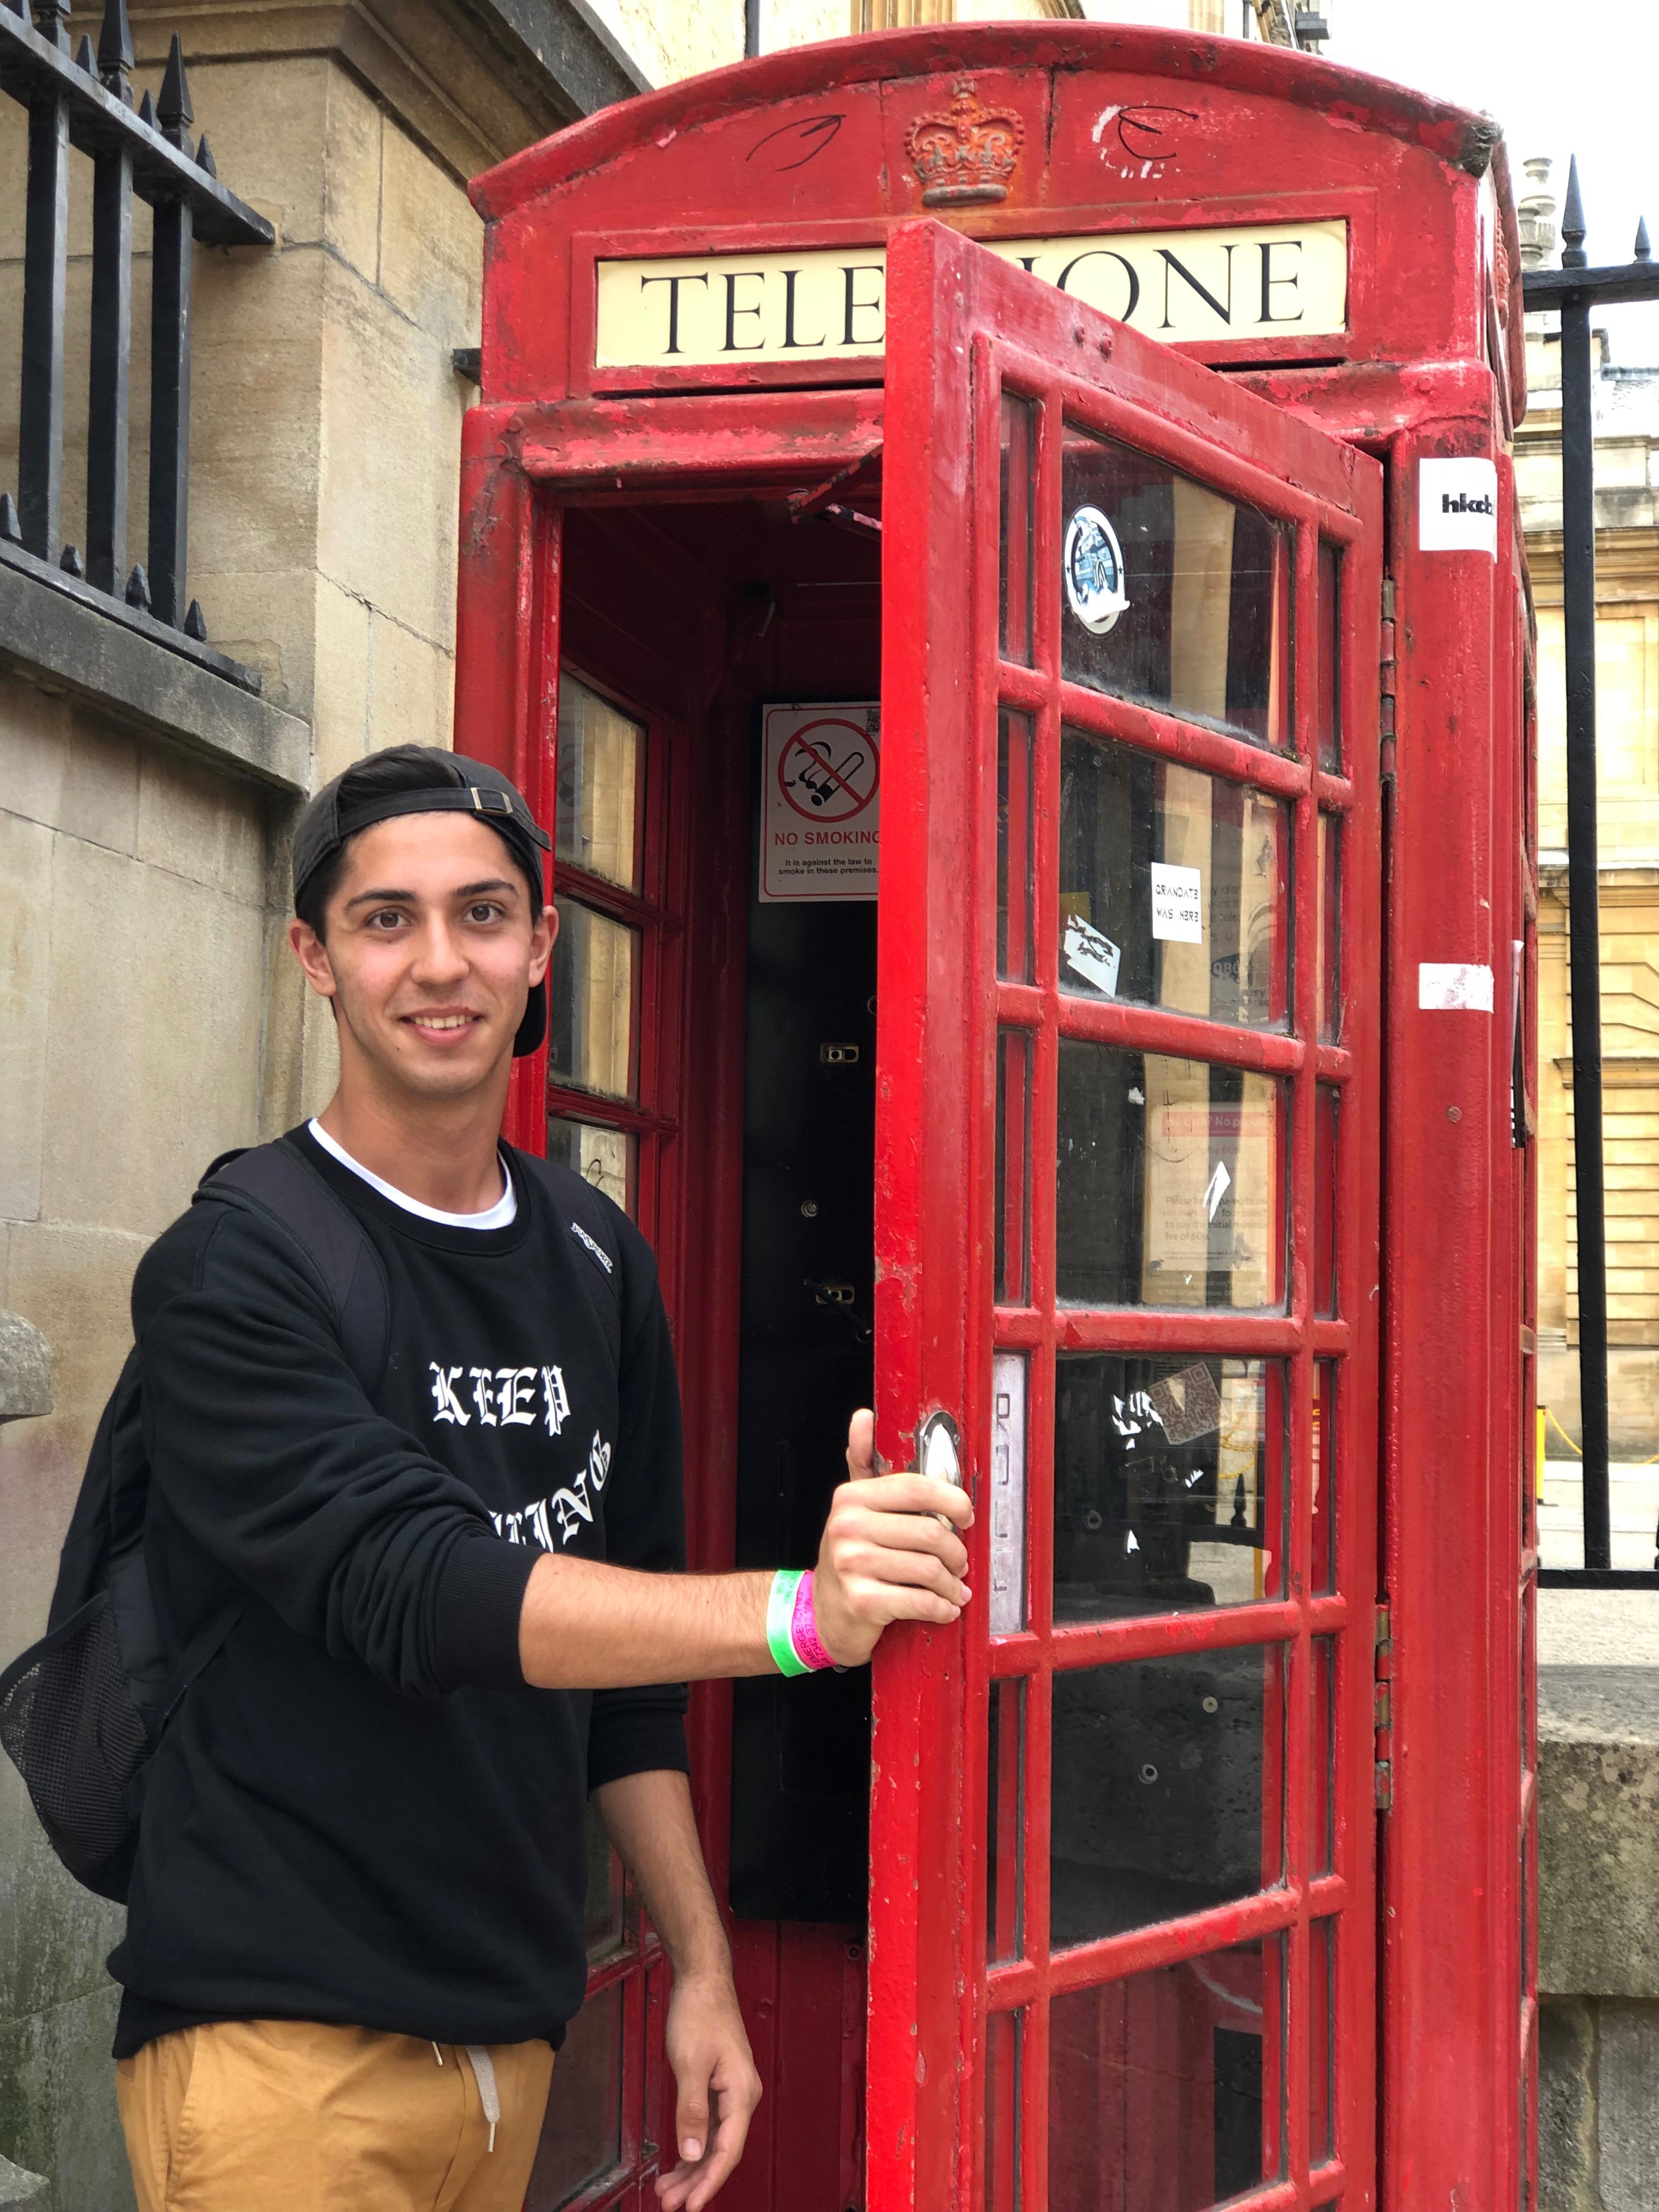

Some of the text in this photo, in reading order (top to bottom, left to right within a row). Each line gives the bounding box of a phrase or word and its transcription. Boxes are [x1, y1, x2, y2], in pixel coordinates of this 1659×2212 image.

[641, 240, 1304, 354] TELEONE
[774, 832, 798, 845] NO
[802, 859, 831, 867] against
[1156, 907, 1173, 919] WAS
[1215, 1116, 1231, 1126] No
[429, 1361, 571, 1437] KEEP
